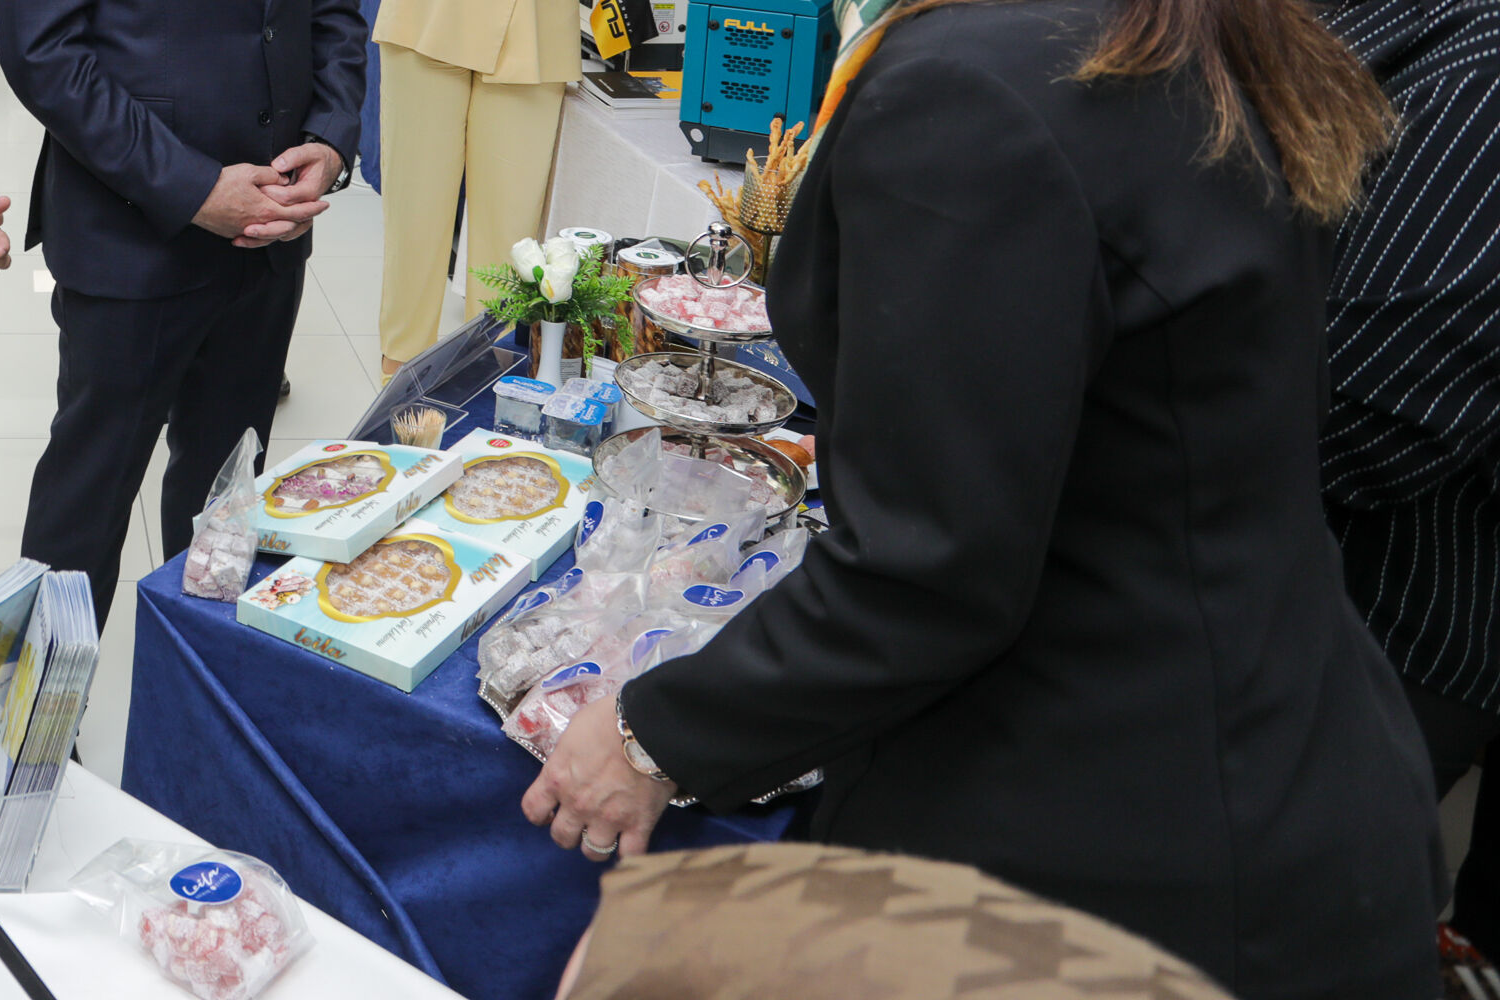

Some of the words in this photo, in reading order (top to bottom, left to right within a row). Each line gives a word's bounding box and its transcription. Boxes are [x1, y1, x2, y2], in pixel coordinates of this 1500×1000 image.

[723, 18, 775, 33] FULL
[469, 553, 513, 585] leila
[293, 627, 348, 660] leila
[182, 866, 219, 896] Leila
